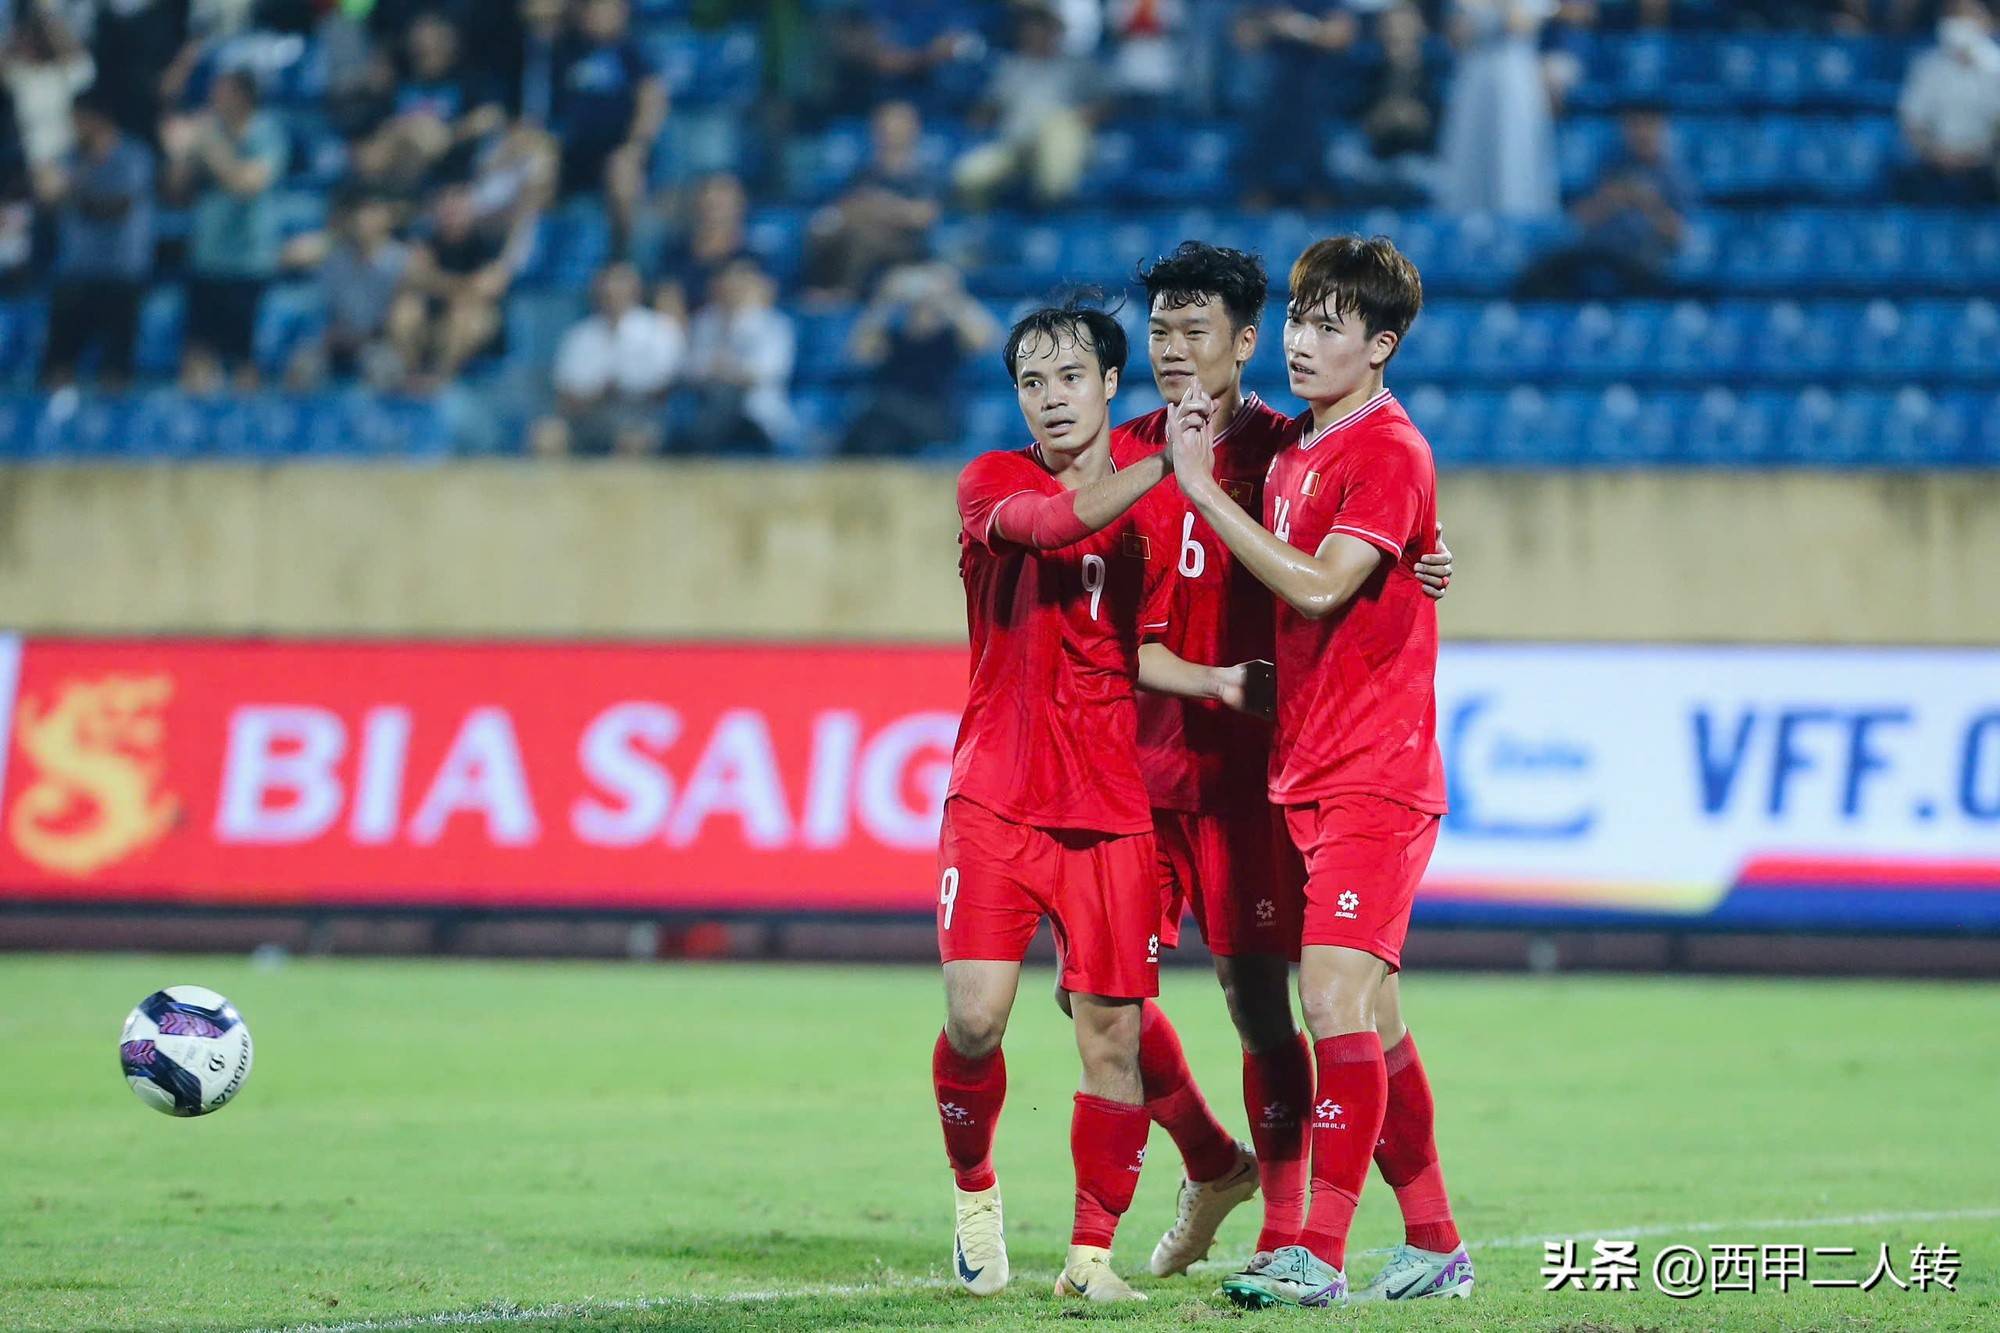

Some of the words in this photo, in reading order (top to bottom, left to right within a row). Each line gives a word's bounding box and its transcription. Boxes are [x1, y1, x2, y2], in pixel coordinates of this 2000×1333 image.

[1178, 511, 1205, 578] 6
[1081, 553, 1106, 621] 9
[216, 703, 540, 846] BIA
[941, 866, 960, 930] 9
